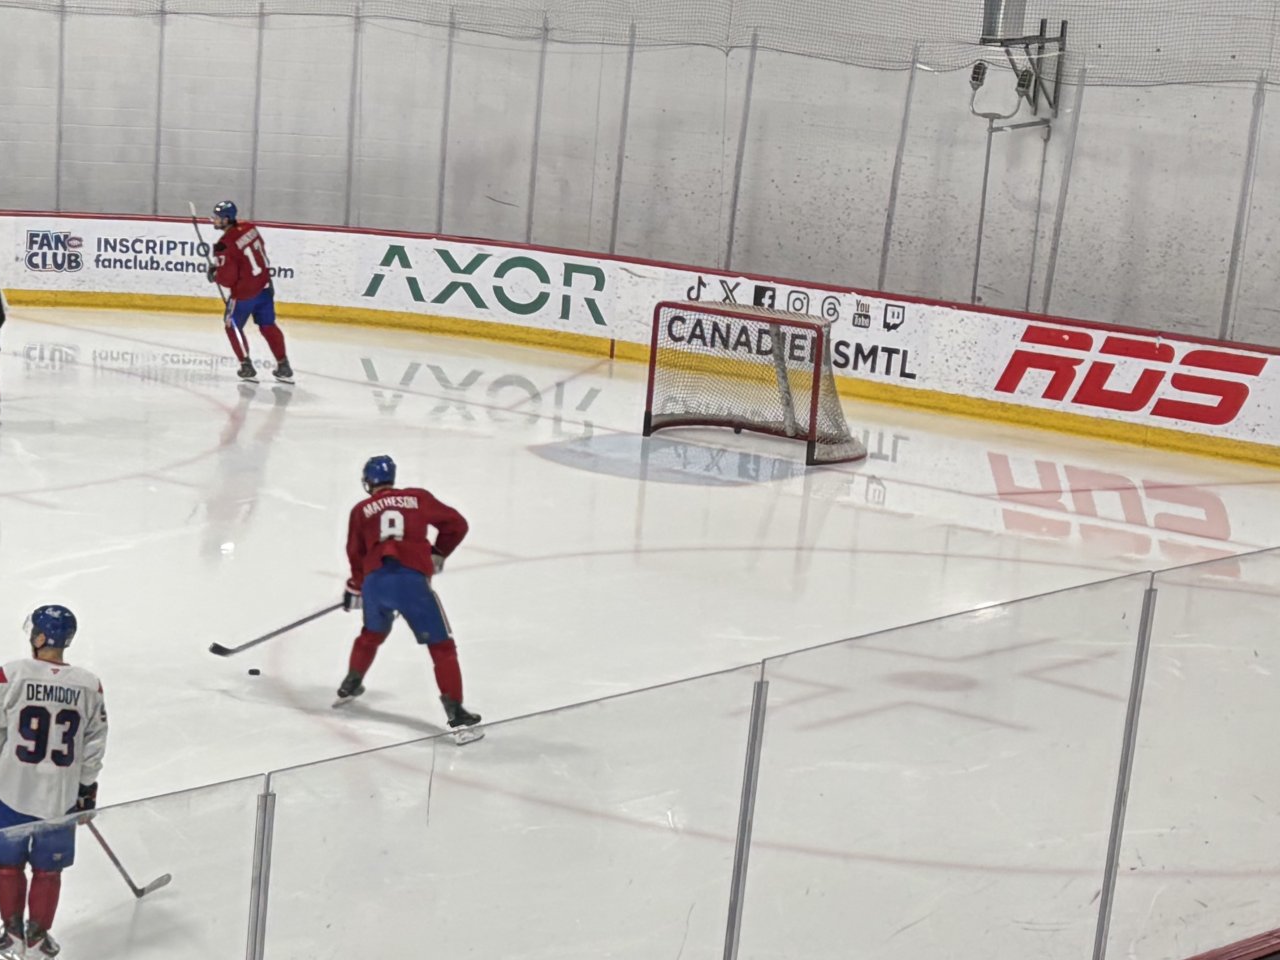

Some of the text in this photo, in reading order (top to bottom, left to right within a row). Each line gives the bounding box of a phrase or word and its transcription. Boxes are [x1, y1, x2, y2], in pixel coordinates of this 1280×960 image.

[27, 231, 71, 251] FAN
[25, 251, 83, 272] CLUB
[361, 245, 608, 326] AXOR
[994, 325, 1269, 425] RDS
[362, 496, 419, 519] MATHESON
[26, 683, 81, 706] DEMIDOV
[15, 705, 81, 767] 93
